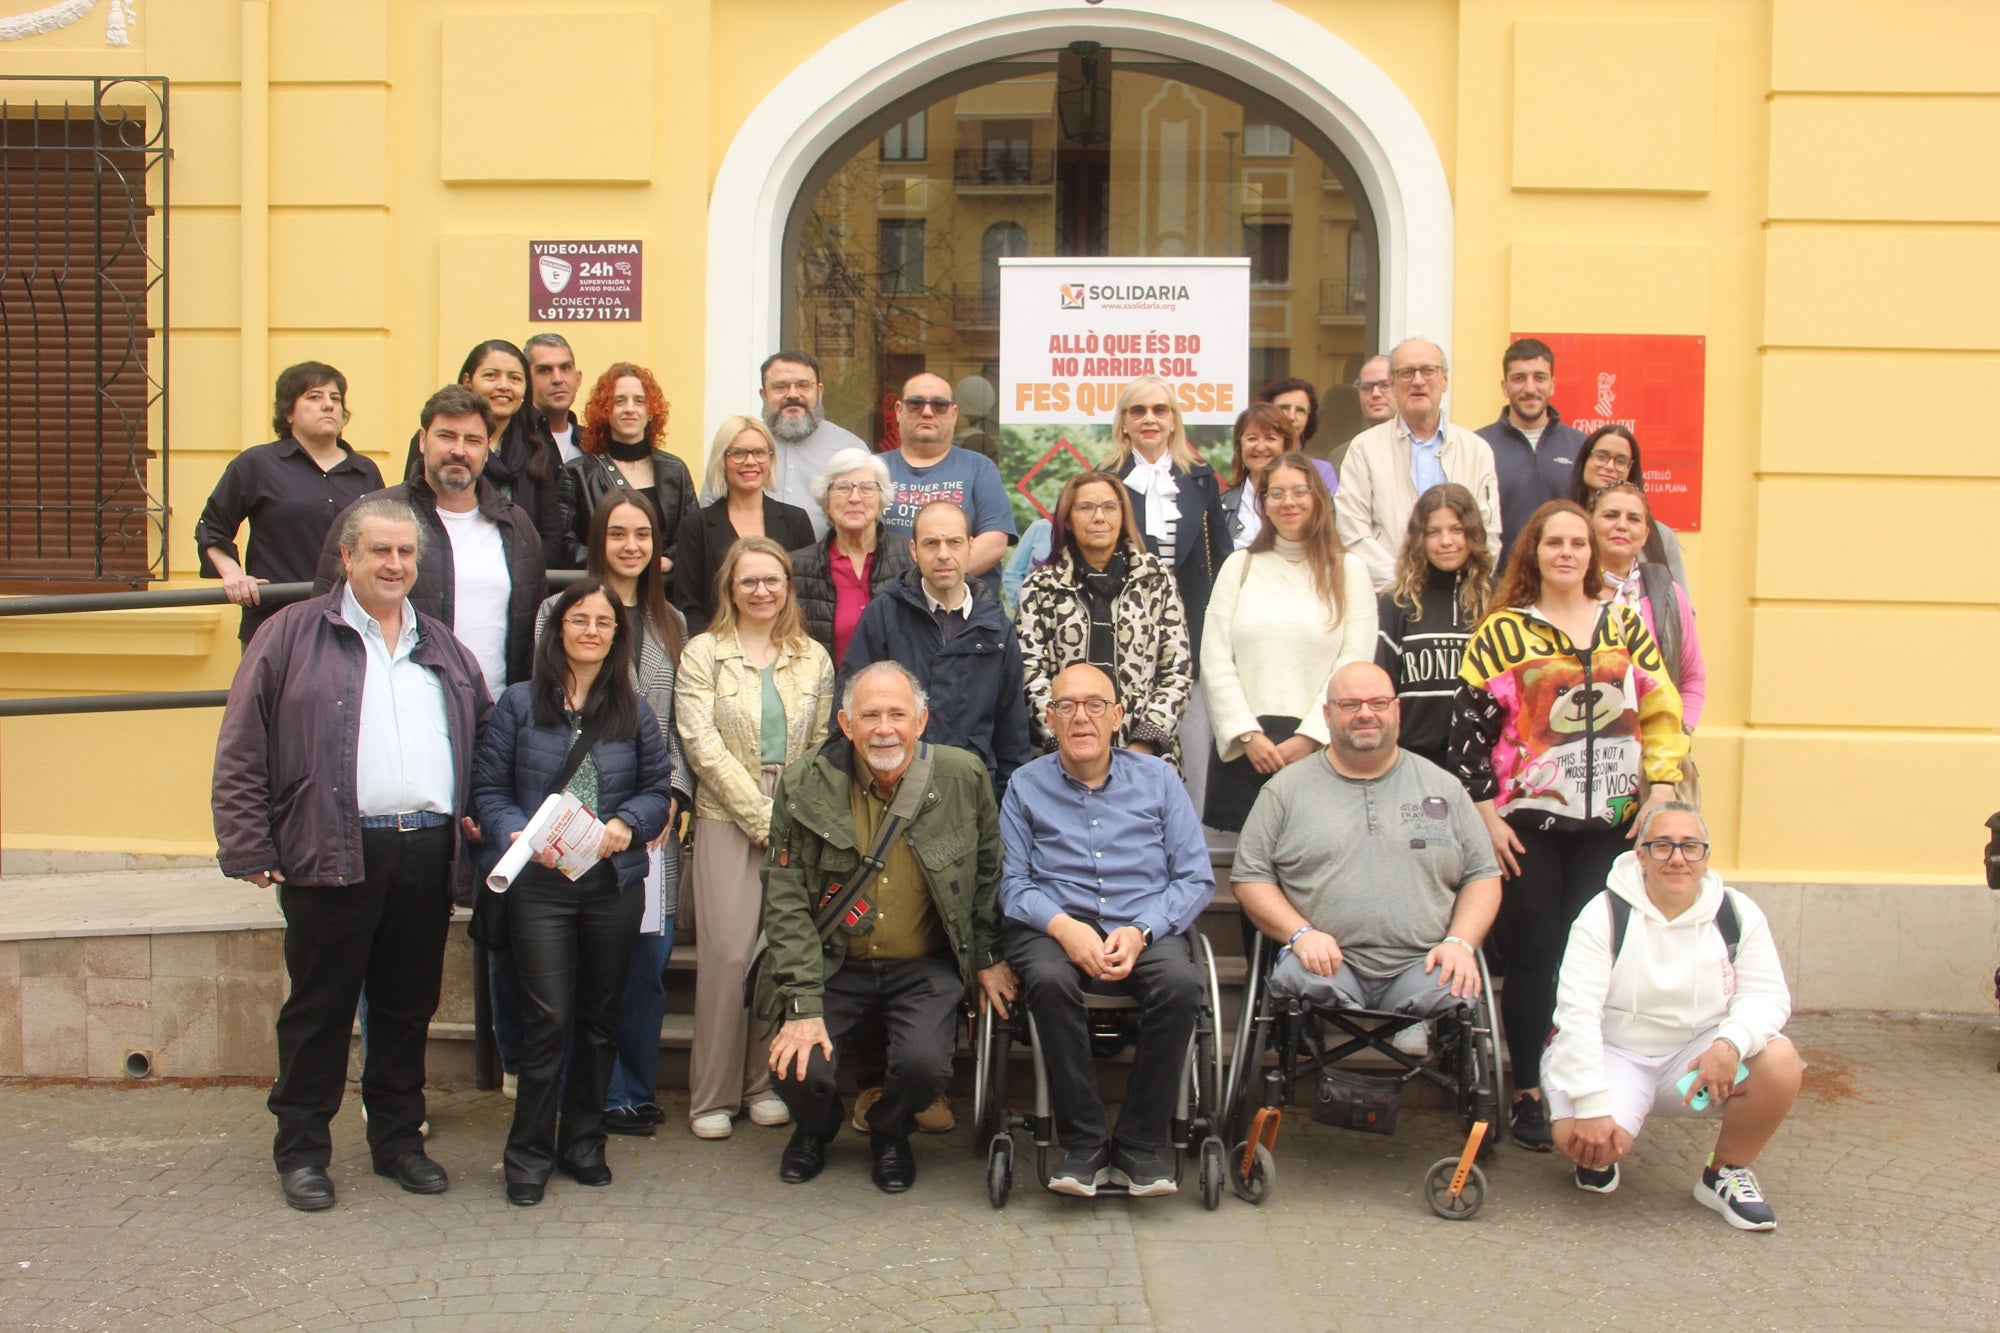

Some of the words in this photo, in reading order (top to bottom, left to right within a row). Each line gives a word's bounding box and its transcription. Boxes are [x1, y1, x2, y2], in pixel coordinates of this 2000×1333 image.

[534, 244, 638, 254] VIDEOALARMA
[579, 262, 613, 277] 24h
[1089, 285, 1190, 301] SOLIDARIA
[552, 297, 621, 306] CONECTADA
[1100, 302, 1176, 312] www.xsolidaria.org
[547, 308, 563, 319] 91
[567, 308, 594, 319] 737
[598, 308, 611, 319] 11
[614, 308, 630, 319] 71
[1048, 330, 1099, 354] ALLÒ
[1103, 334, 1142, 356] QUE
[1146, 330, 1170, 354] ÉS
[1174, 334, 1201, 354] BO
[1052, 358, 1079, 377] NO
[1083, 358, 1155, 377] ARRIBA
[1159, 358, 1197, 377] SOL
[1015, 383, 1070, 412] FES
[1172, 384, 1233, 412] SSE
[1642, 469, 1671, 480] ASTELLÓ
[892, 481, 907, 491] SS
[942, 481, 964, 490] THE
[1655, 483, 1664, 492] LA
[1665, 483, 1688, 493] PLANA
[893, 490, 964, 505] SKATES
[1557, 753, 1576, 768] THIS
[1603, 746, 1618, 761] NOT
[1618, 748, 1625, 760] A
